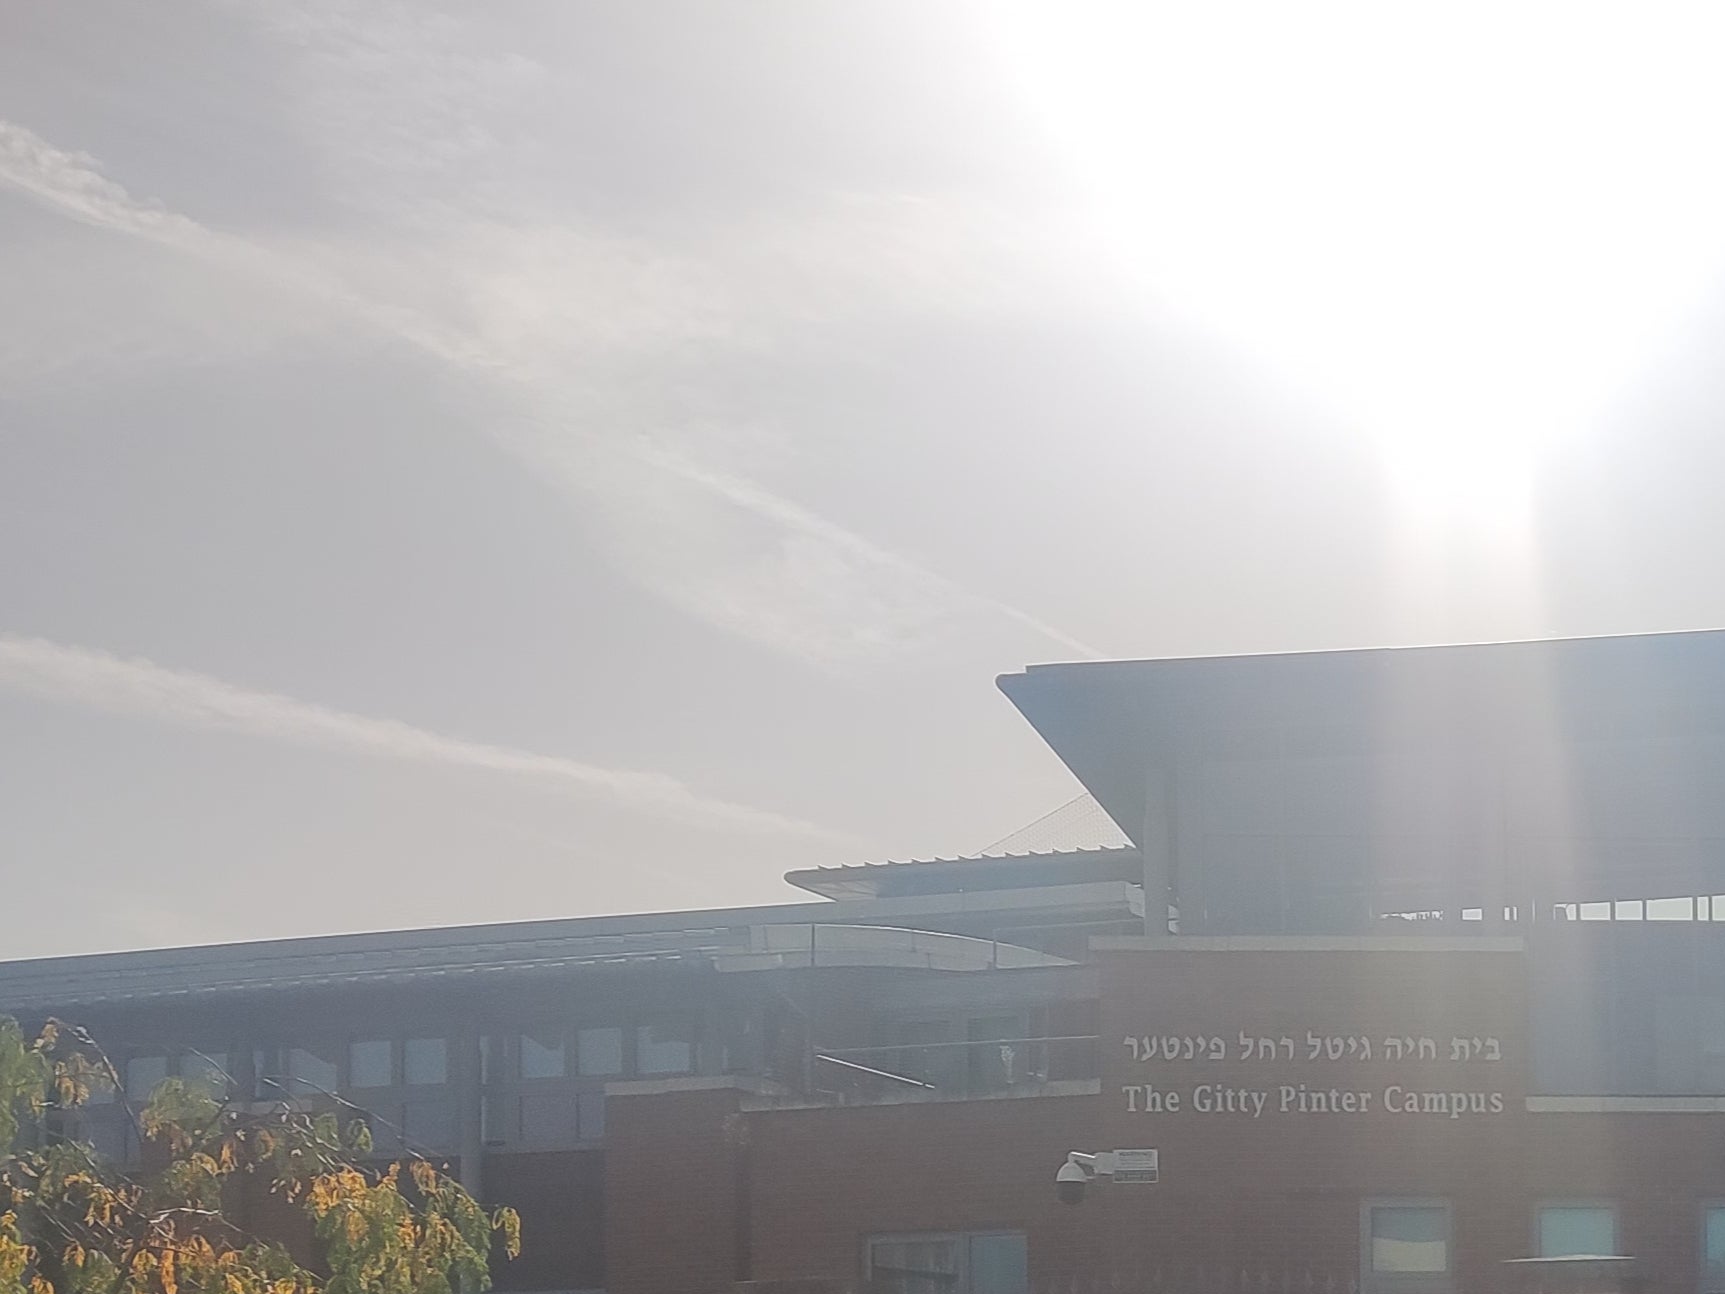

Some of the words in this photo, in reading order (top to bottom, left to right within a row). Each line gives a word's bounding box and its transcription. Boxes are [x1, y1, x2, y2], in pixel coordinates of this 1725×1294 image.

[1122, 1034, 1227, 1062] פינטער
[1238, 1029, 1295, 1061] רחל
[1306, 1029, 1372, 1061] גיטל
[1383, 1036, 1437, 1061] חיה
[1450, 1036, 1502, 1062] בית
[1121, 1083, 1181, 1112] The
[1192, 1083, 1268, 1119] Gitty
[1278, 1083, 1372, 1113] Pinter
[1382, 1084, 1505, 1119] Campus
